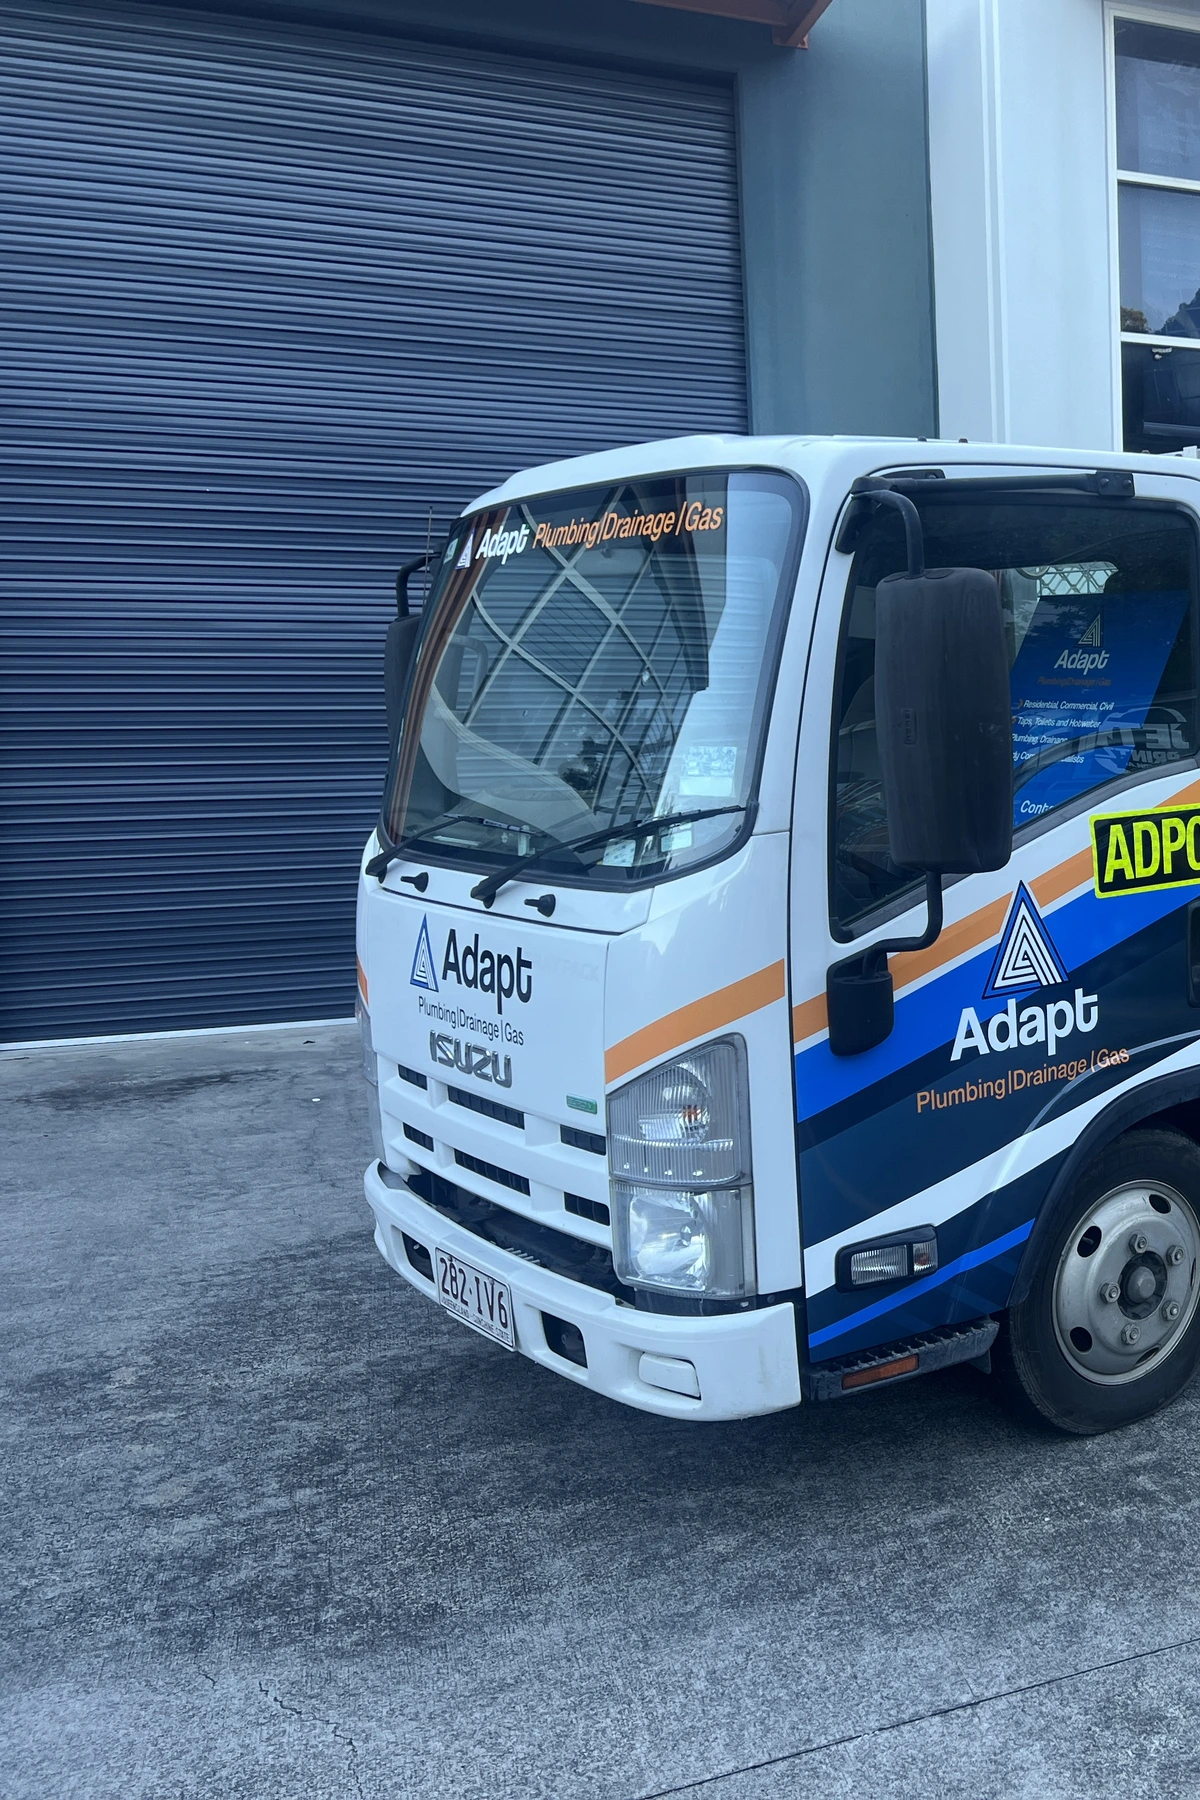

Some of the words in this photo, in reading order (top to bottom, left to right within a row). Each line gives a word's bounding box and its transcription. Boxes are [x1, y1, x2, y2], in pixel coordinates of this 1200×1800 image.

[475, 522, 532, 566] Adapt
[1053, 649, 1110, 675] Adapt
[1034, 717, 1056, 727] Toilets
[1056, 718, 1070, 727] and
[1099, 702, 1115, 711] Civil
[441, 927, 533, 1015] Adapt
[950, 987, 1099, 1063] Adapt
[429, 1029, 513, 1089] ISUZU
